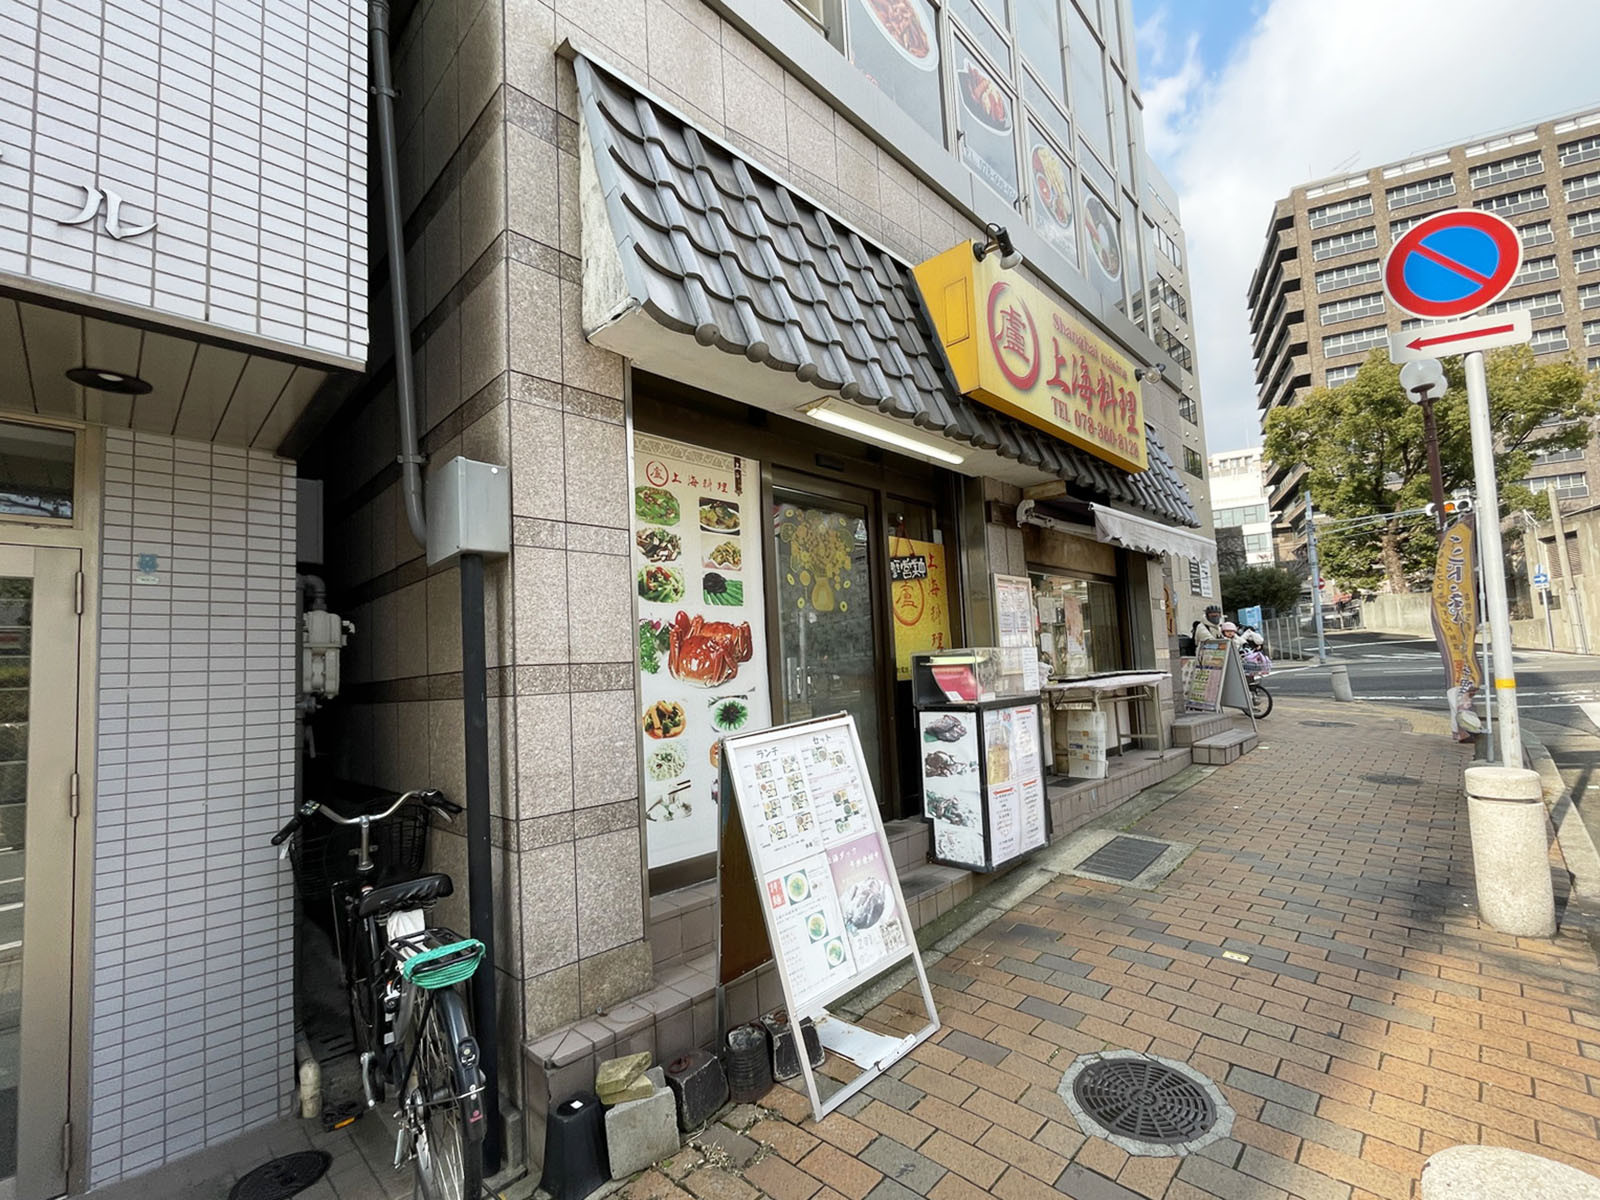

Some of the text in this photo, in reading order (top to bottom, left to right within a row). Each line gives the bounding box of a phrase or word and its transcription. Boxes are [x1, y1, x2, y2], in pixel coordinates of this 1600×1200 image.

[1052, 312, 1129, 381] Shanghai cuisine
[1046, 336, 1140, 436] 上海料理
[1050, 396, 1071, 424] TEL
[671, 472, 729, 494] 上海料理
[927, 552, 945, 651] 上海料理
[756, 746, 779, 760] ランチ
